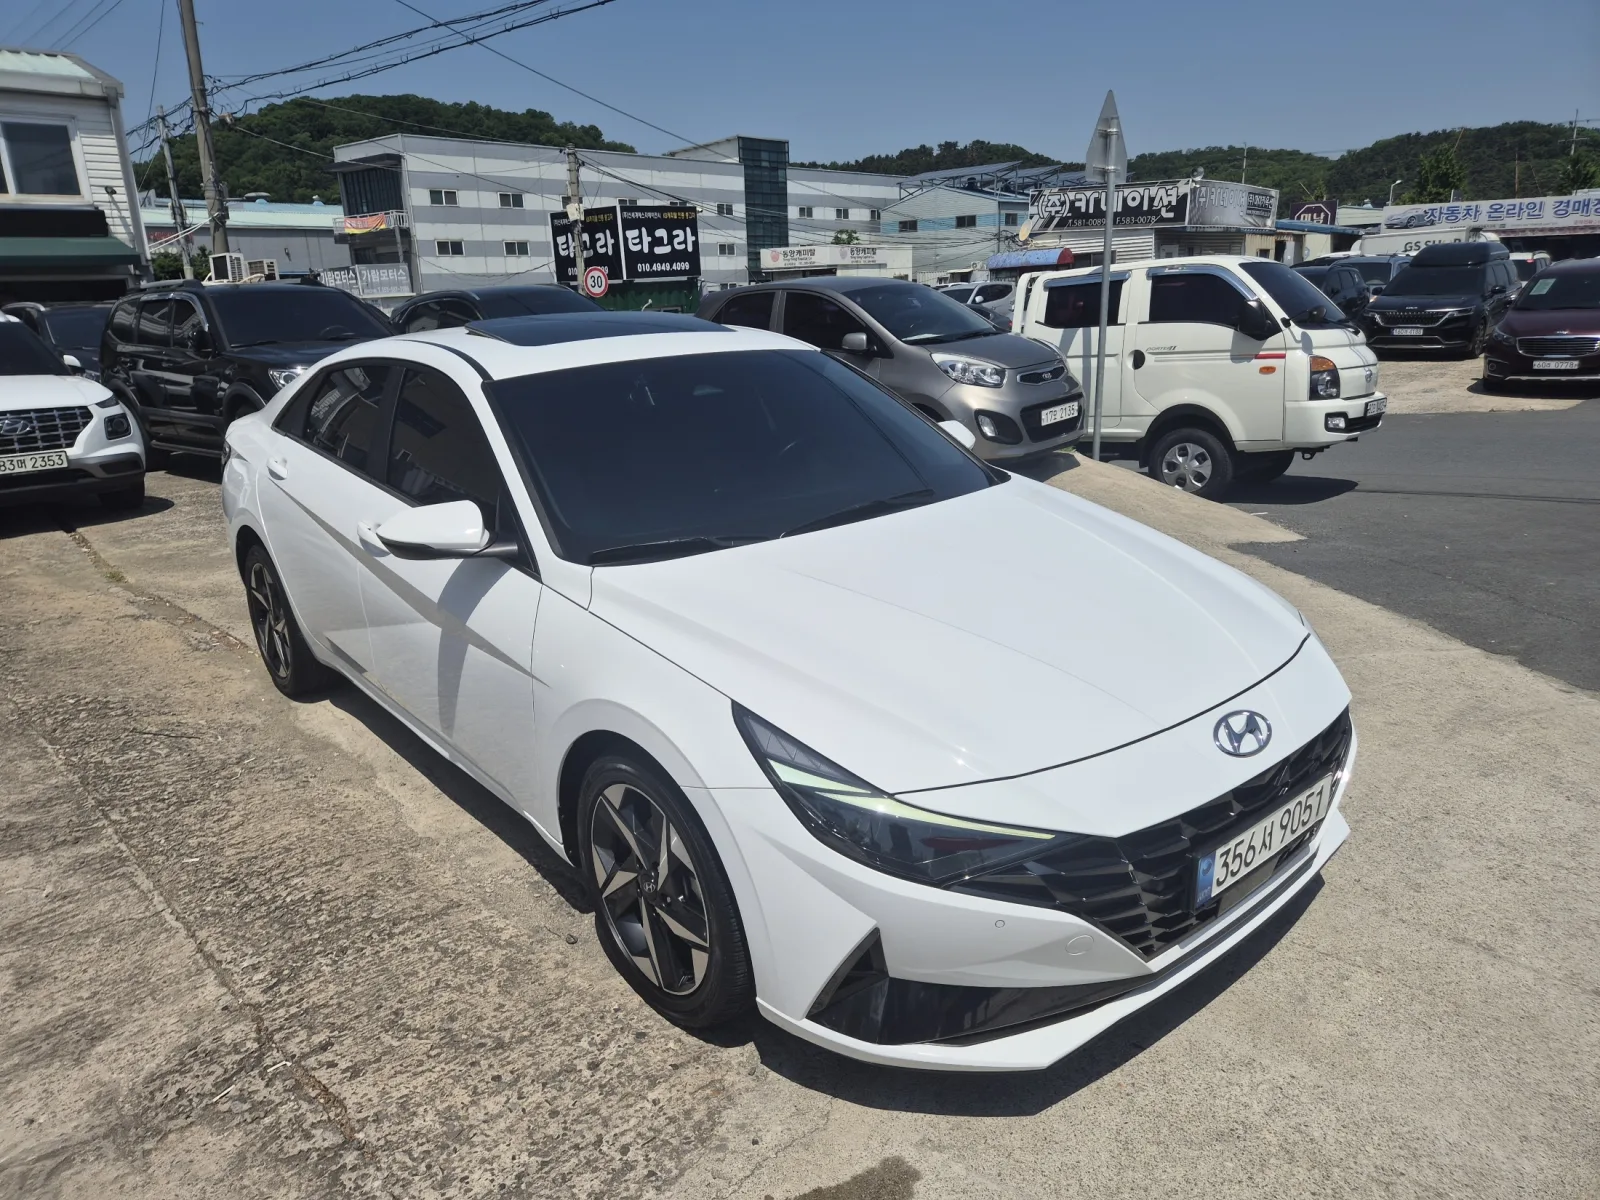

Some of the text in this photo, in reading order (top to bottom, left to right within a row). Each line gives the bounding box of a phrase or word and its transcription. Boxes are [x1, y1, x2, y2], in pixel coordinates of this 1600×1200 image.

[1425, 204, 1481, 224] 자동차
[1487, 200, 1545, 221] 온라인
[625, 226, 696, 255] 타그라
[1404, 241, 1421, 252] GS
[637, 262, 690, 272] 010.4949.4099
[361, 268, 407, 282] 가람모터스
[590, 276, 603, 289] 30
[1060, 404, 1076, 418] 2135
[30, 455, 64, 468] 2353
[1216, 785, 1324, 888] 356서 9051
